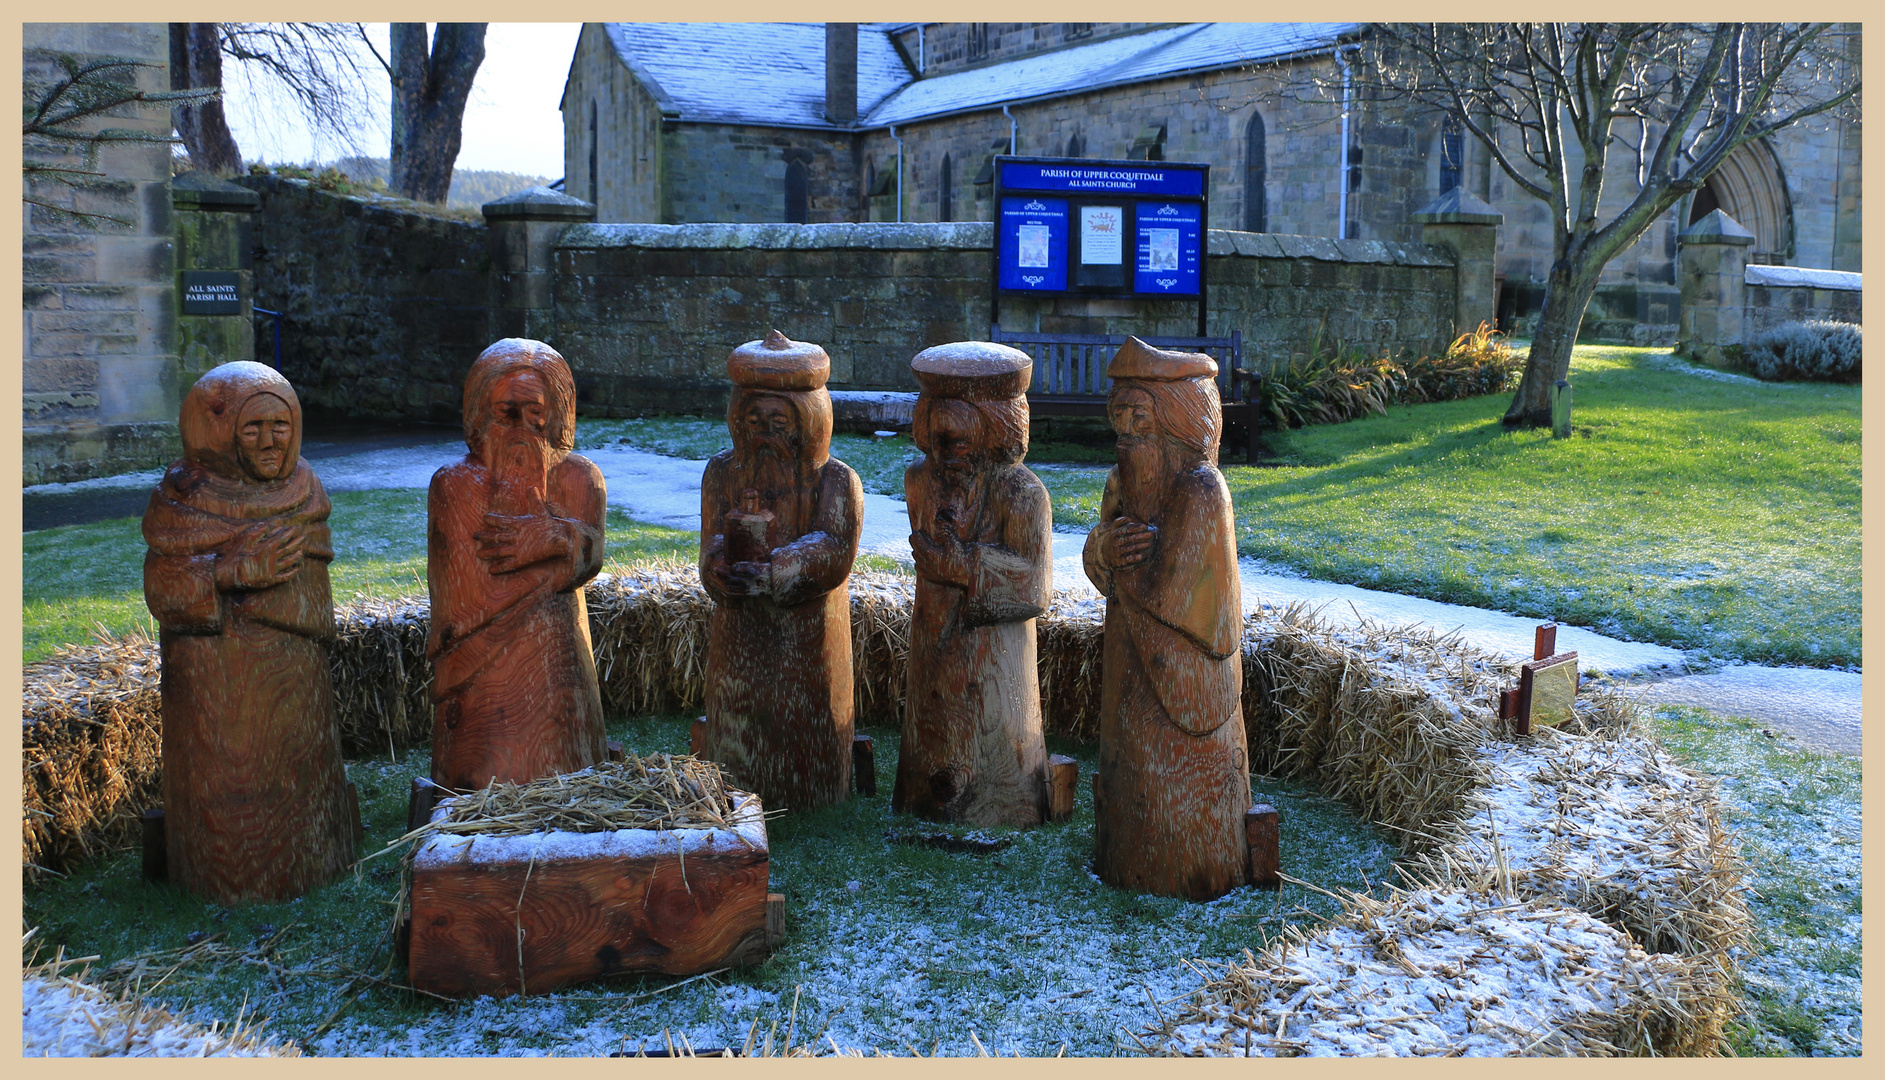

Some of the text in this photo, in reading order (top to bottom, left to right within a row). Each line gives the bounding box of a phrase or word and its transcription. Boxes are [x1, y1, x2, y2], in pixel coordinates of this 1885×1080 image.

[1040, 169, 1164, 181] PARISH OF UPPER COQUETDALE
[1081, 180, 1105, 188] SAINTS
[1105, 181, 1136, 189] CHURCH
[189, 285, 205, 293] ALL
